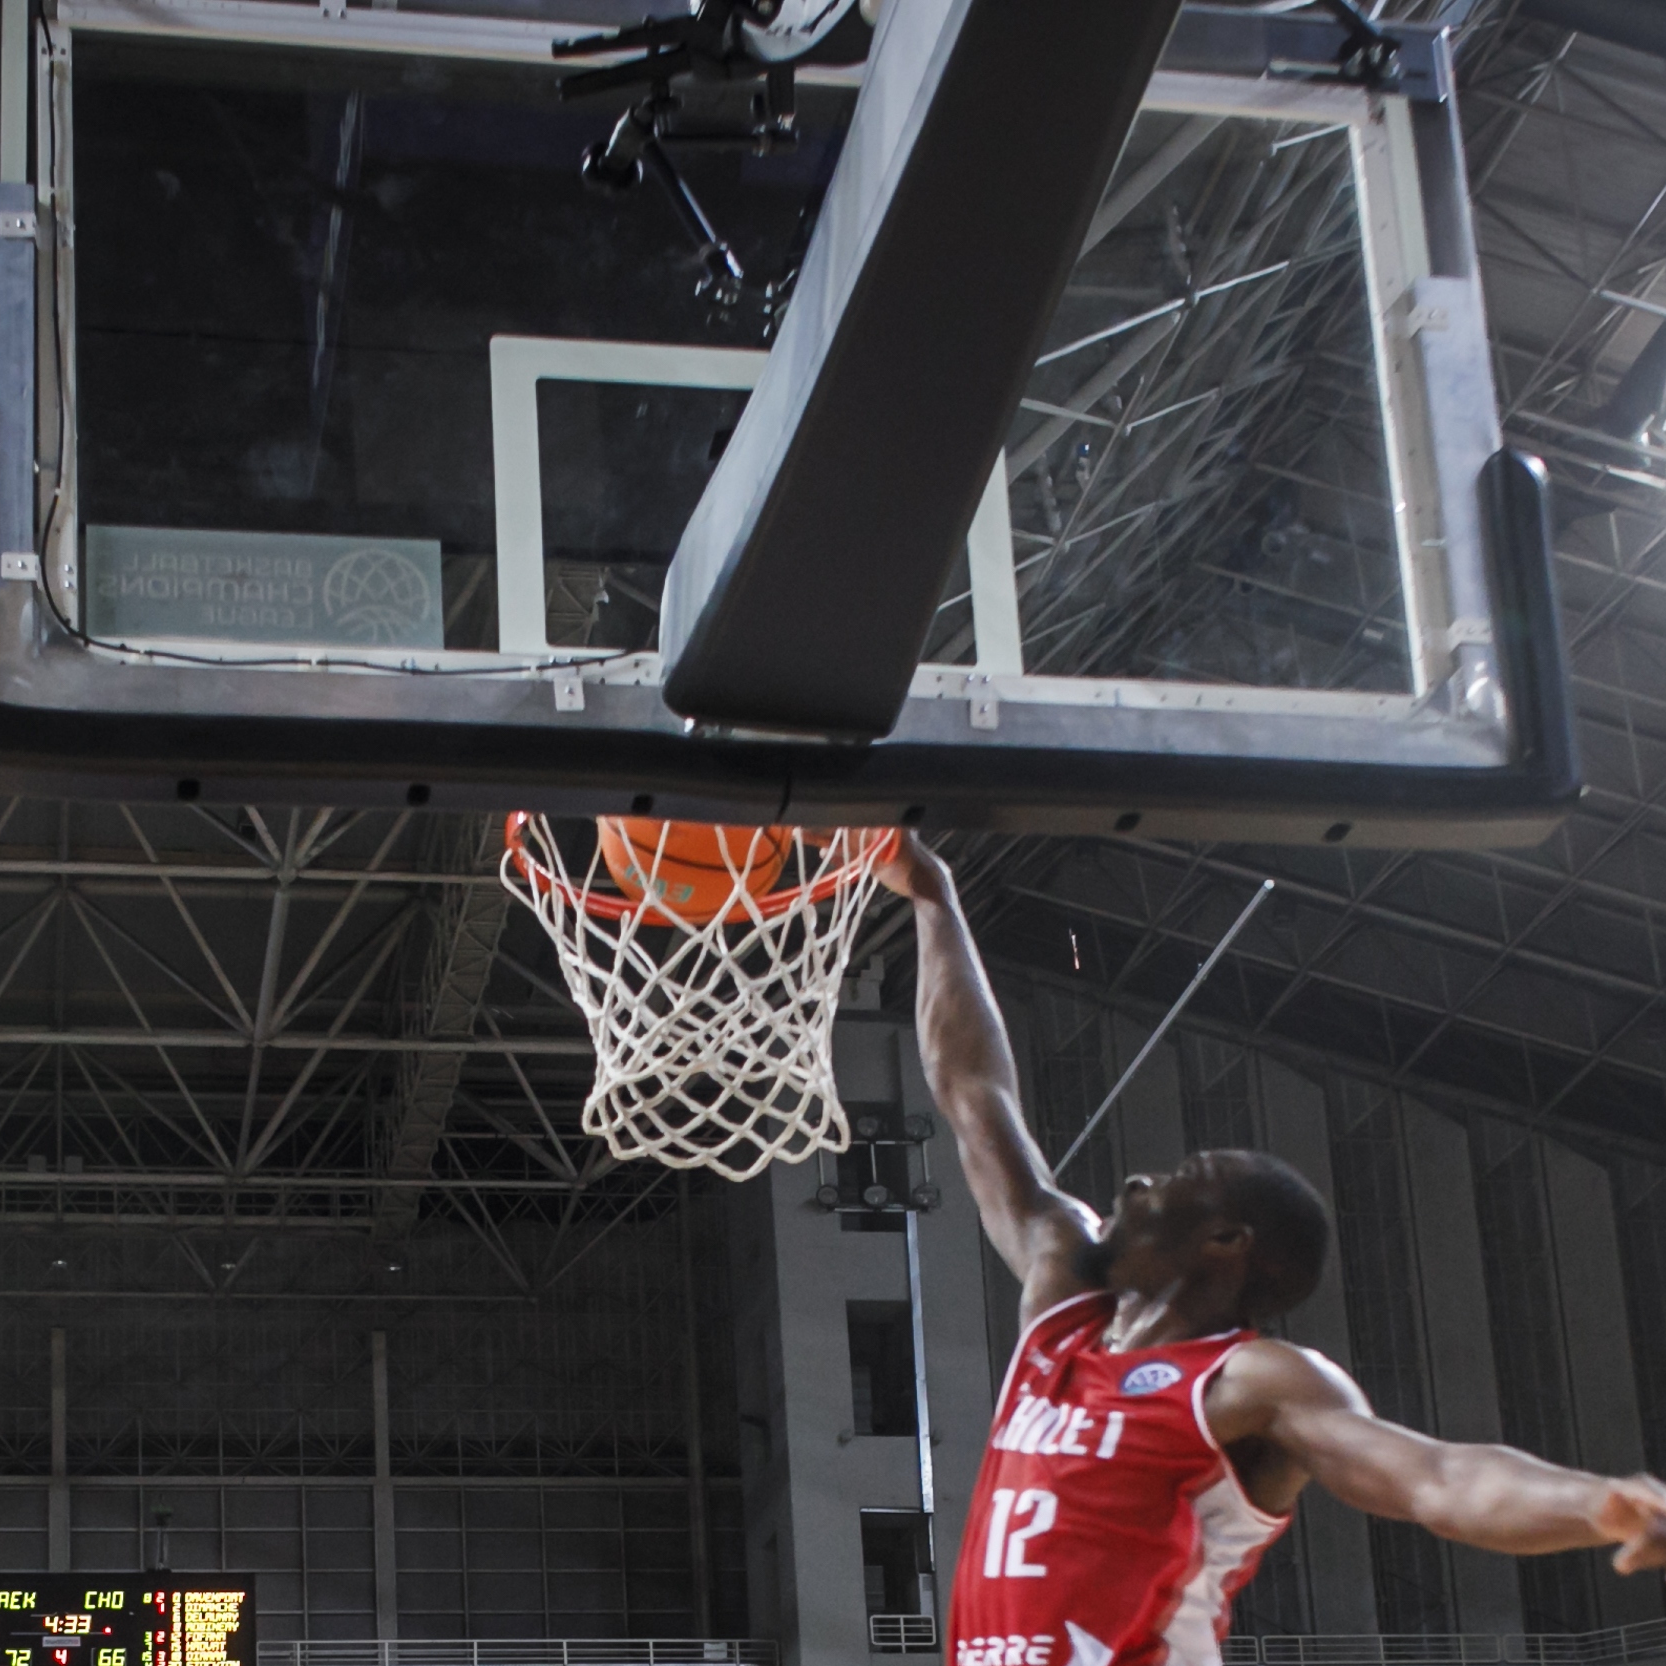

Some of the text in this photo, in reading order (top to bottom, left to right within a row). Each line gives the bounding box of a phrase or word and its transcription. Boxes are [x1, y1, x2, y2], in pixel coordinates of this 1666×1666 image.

[983, 1489, 1058, 1578] 12
[84, 1591, 124, 1609] CHO
[44, 1615, 91, 1633] 4:33
[156, 1632, 165, 1642] 2
[5, 1649, 31, 1666] 72
[55, 1649, 67, 1664] 4
[98, 1649, 126, 1666] 66
[157, 1651, 165, 1661] 3
